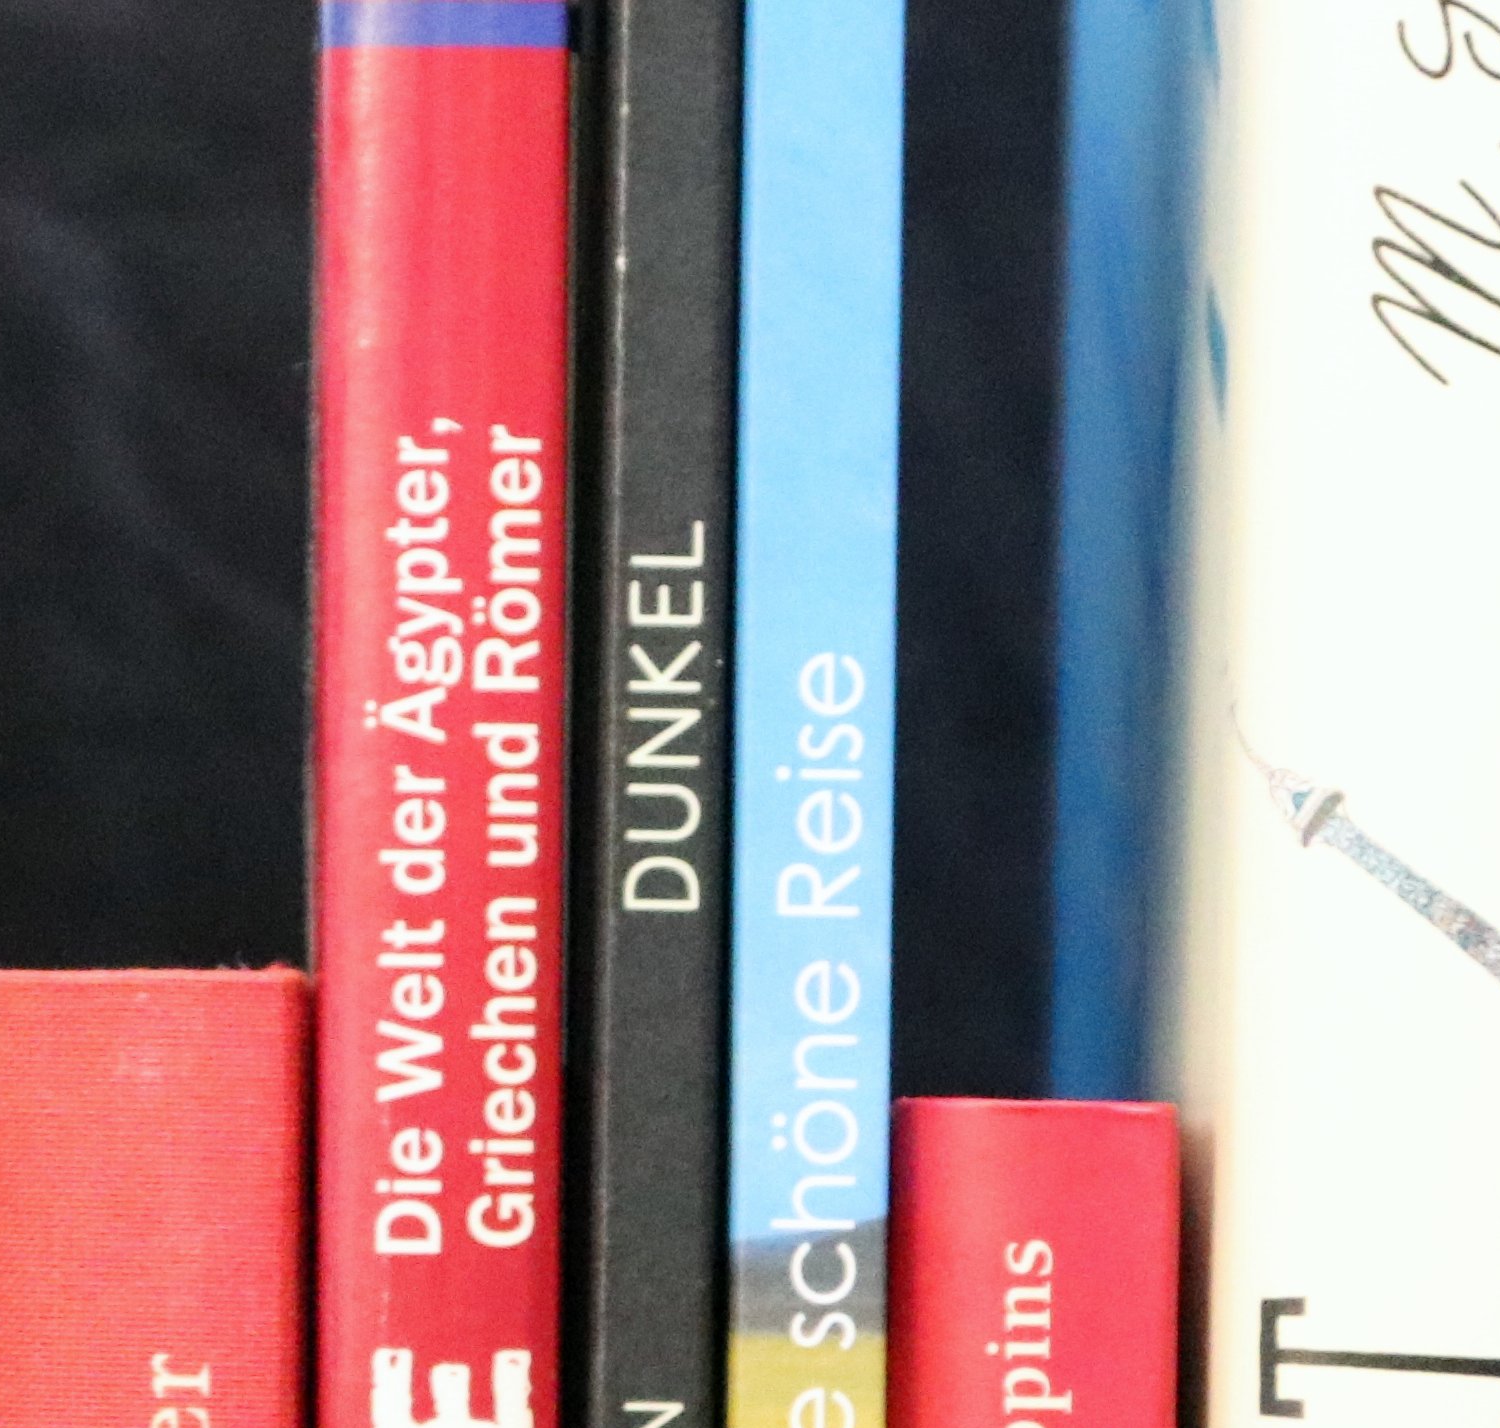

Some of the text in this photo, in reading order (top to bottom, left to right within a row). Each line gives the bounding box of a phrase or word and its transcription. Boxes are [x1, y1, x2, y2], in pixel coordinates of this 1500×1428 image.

[364, 416, 464, 1257] Die Welt der Ägypter,
[467, 424, 544, 1248] Griechen und Römer
[623, 519, 705, 912] DUNKEL
[775, 650, 866, 918] Reise
[769, 959, 862, 1352] schöne
